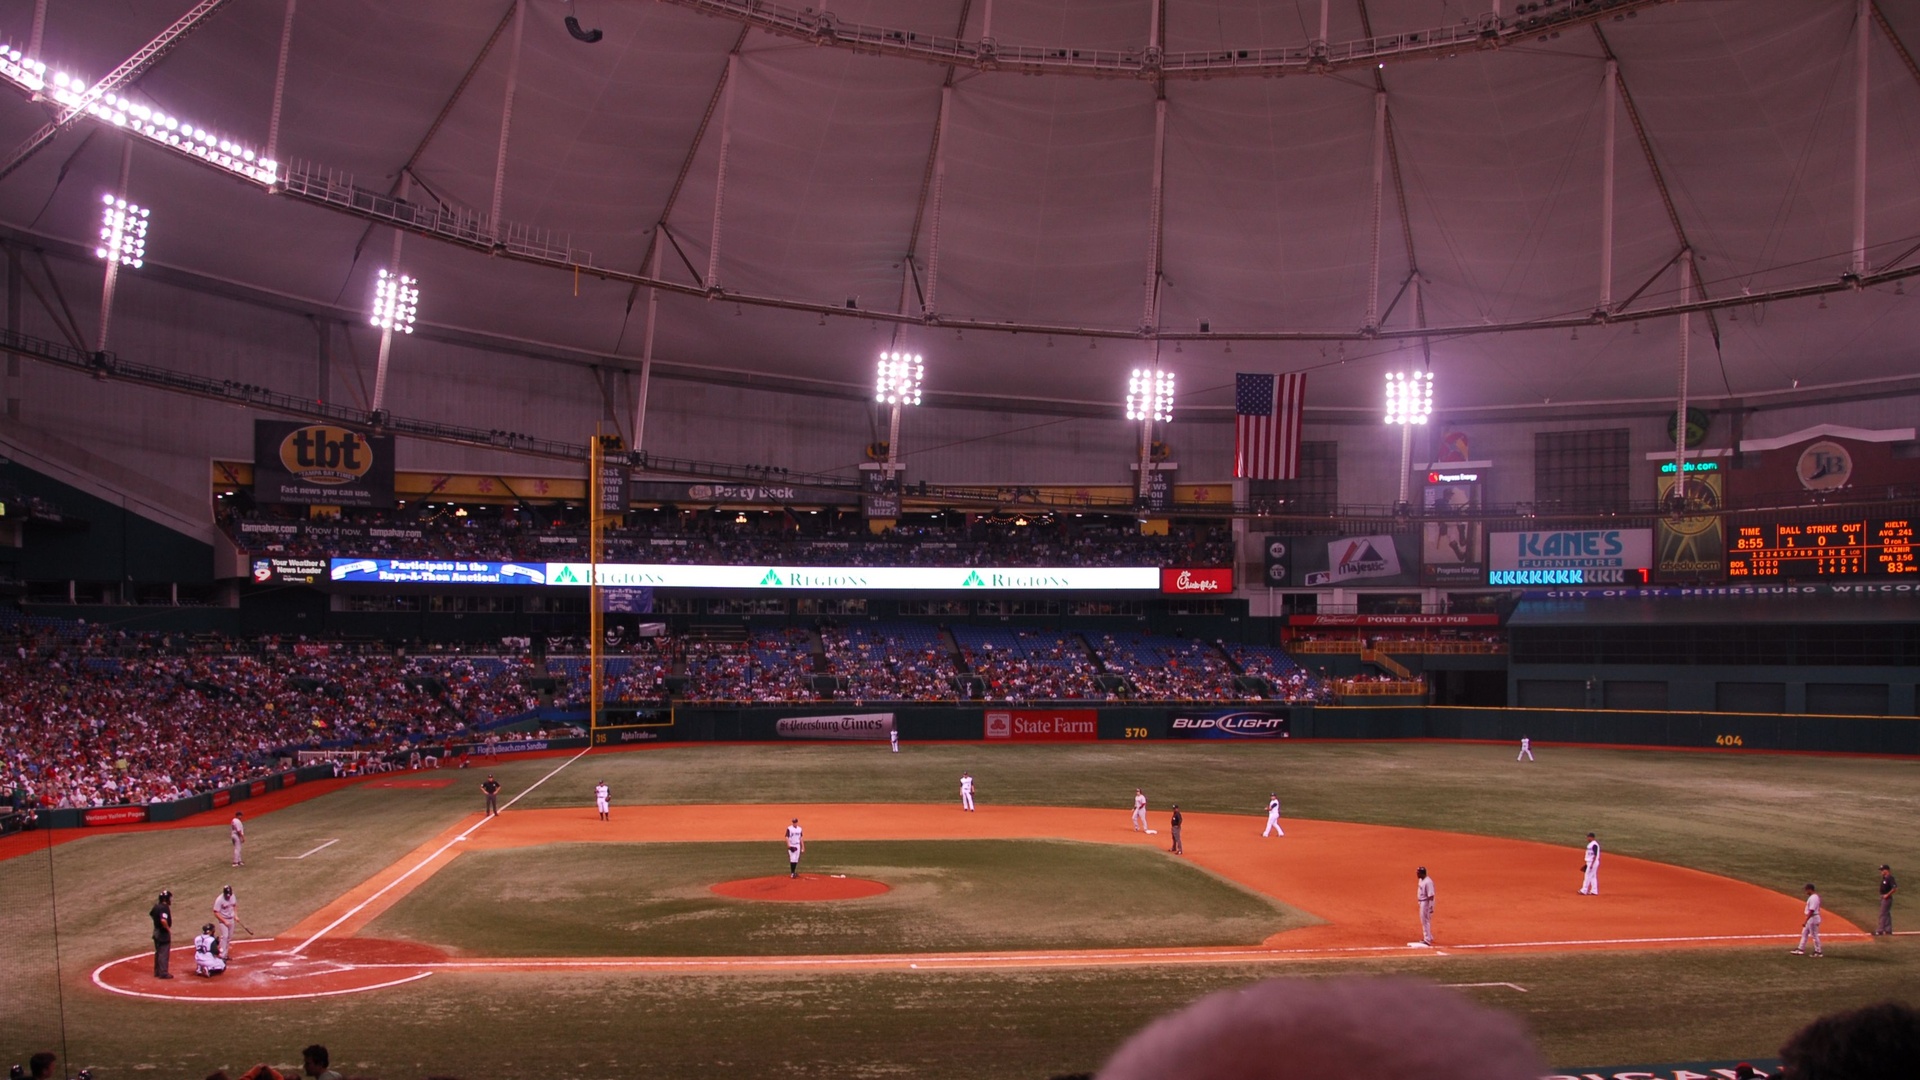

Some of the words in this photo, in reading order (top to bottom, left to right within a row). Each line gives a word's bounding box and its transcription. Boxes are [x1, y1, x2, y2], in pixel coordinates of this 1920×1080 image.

[293, 430, 360, 470] tbt
[1661, 462, 1718, 473] afsdu.com
[281, 485, 298, 494] Fast
[300, 487, 321, 495] news
[323, 488, 338, 498] you
[601, 485, 619, 494] you
[715, 485, 755, 500] Party
[601, 494, 619, 502] can
[868, 507, 896, 516] buzz?
[305, 525, 331, 534] Know
[333, 525, 339, 535] it
[341, 528, 362, 536] now.
[1740, 527, 1761, 536] TIME
[1780, 526, 1801, 535] BALL
[1806, 524, 1838, 534] STRIKE
[1842, 523, 1861, 533] OUT
[1897, 528, 1913, 536] .241
[1518, 531, 1623, 557] KANE'S
[1738, 538, 1764, 549] 8:55
[1787, 537, 1794, 547] 1
[1818, 536, 1826, 546] 0
[1848, 534, 1856, 545] 1
[272, 558, 288, 567] Your
[289, 559, 318, 567] Weather
[319, 559, 326, 567] &
[391, 560, 454, 572] Participate
[455, 562, 468, 571] in
[469, 562, 488, 571] the
[1338, 561, 1384, 575] Majestic
[1522, 559, 1616, 567] FURNITURE
[1660, 561, 1720, 571] afsedu.com
[1887, 562, 1904, 573] 83
[254, 569, 271, 581] 9
[277, 566, 295, 574] News
[295, 566, 322, 574] Leader
[1436, 567, 1459, 575] Progress
[1460, 566, 1479, 575] Energy
[1638, 568, 1649, 583] 7
[379, 571, 450, 582] Rays-A-Thon
[452, 573, 500, 582] Auction!
[1681, 587, 1817, 596] PETERSBURG
[790, 718, 839, 732] Petersburg
[841, 717, 884, 730] Times
[1014, 717, 1051, 734] State
[1053, 717, 1094, 733] Farm
[1172, 718, 1216, 728] BUD
[1225, 718, 1283, 728] LIGHT
[596, 733, 607, 743] 315
[621, 731, 657, 742] AlphaTrade.com
[1124, 728, 1148, 738] 370
[1716, 734, 1742, 746] 404
[526, 742, 548, 750] Sandbar
